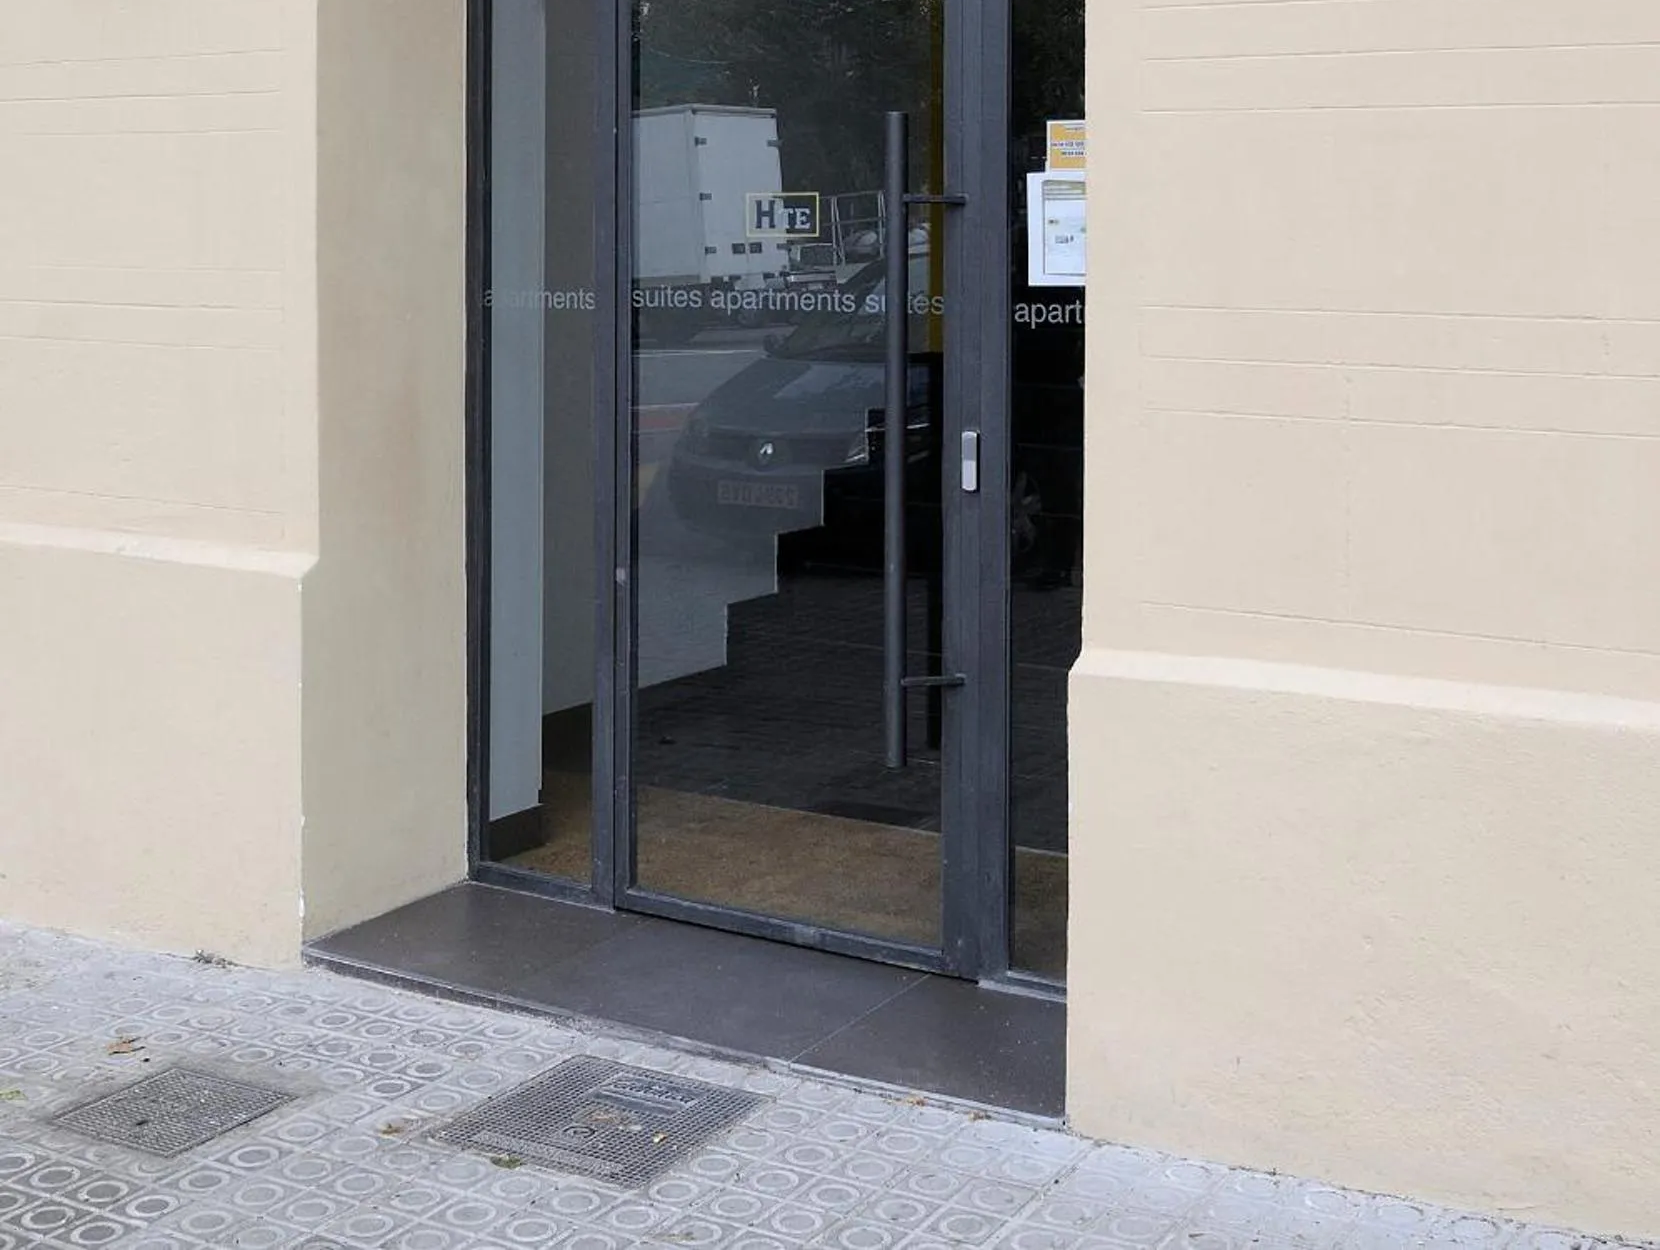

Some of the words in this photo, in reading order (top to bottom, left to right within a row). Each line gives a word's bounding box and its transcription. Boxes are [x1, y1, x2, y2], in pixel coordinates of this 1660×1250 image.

[755, 199, 811, 229] HTE
[484, 288, 596, 311] aartments
[633, 285, 702, 308] suites
[711, 288, 856, 316] apartments
[865, 293, 944, 315] stes
